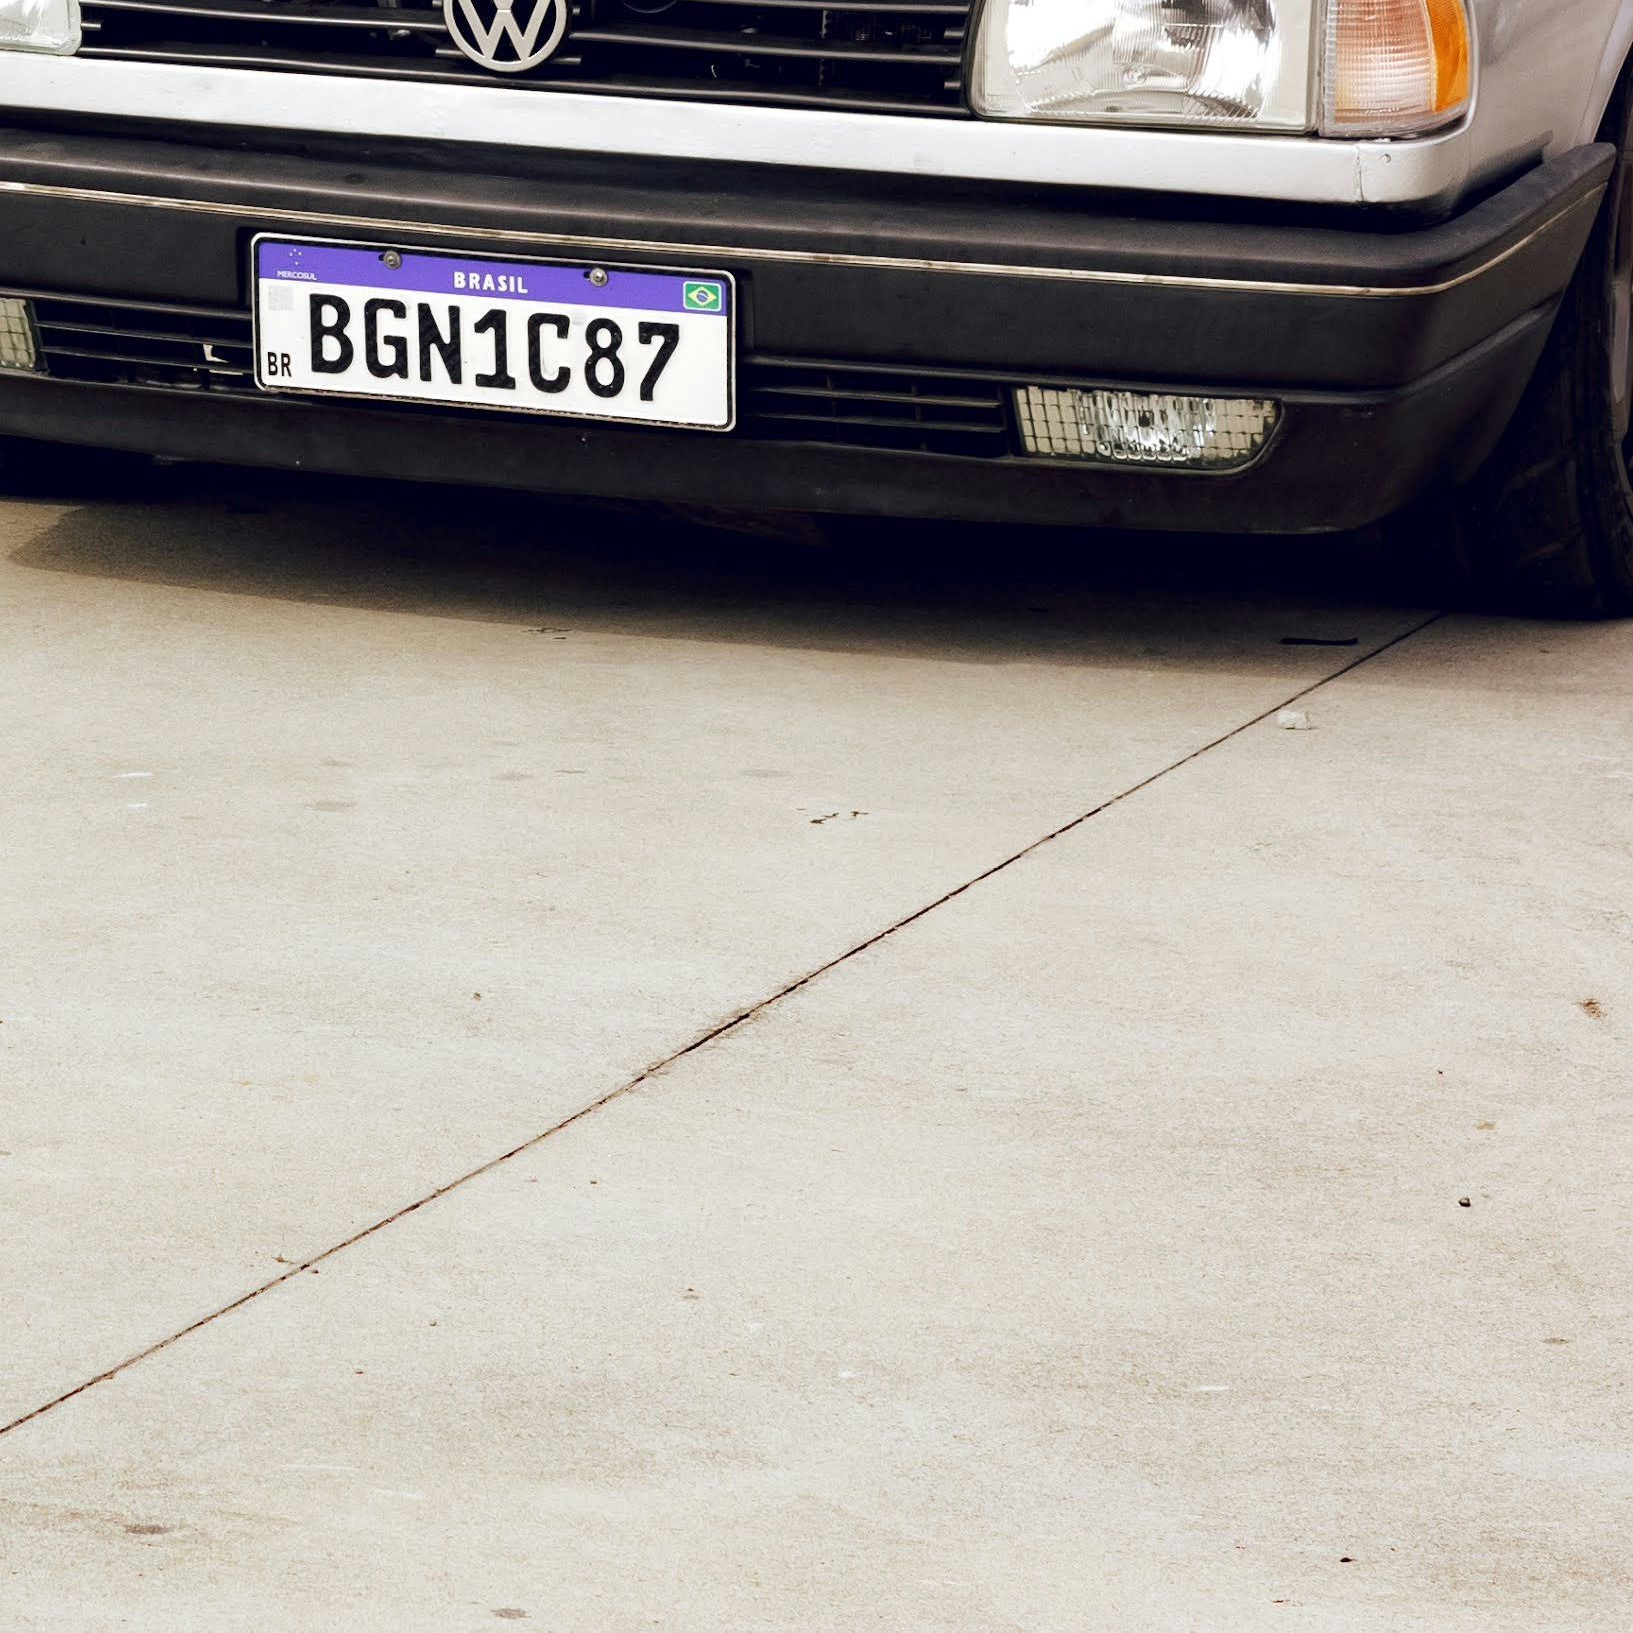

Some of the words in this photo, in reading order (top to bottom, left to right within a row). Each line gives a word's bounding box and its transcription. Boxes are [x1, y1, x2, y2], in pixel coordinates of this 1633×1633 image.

[277, 270, 318, 281] MERCOSUL
[454, 271, 528, 295] BRASIL
[309, 292, 679, 402] BGN1C87
[267, 351, 292, 377] BR
